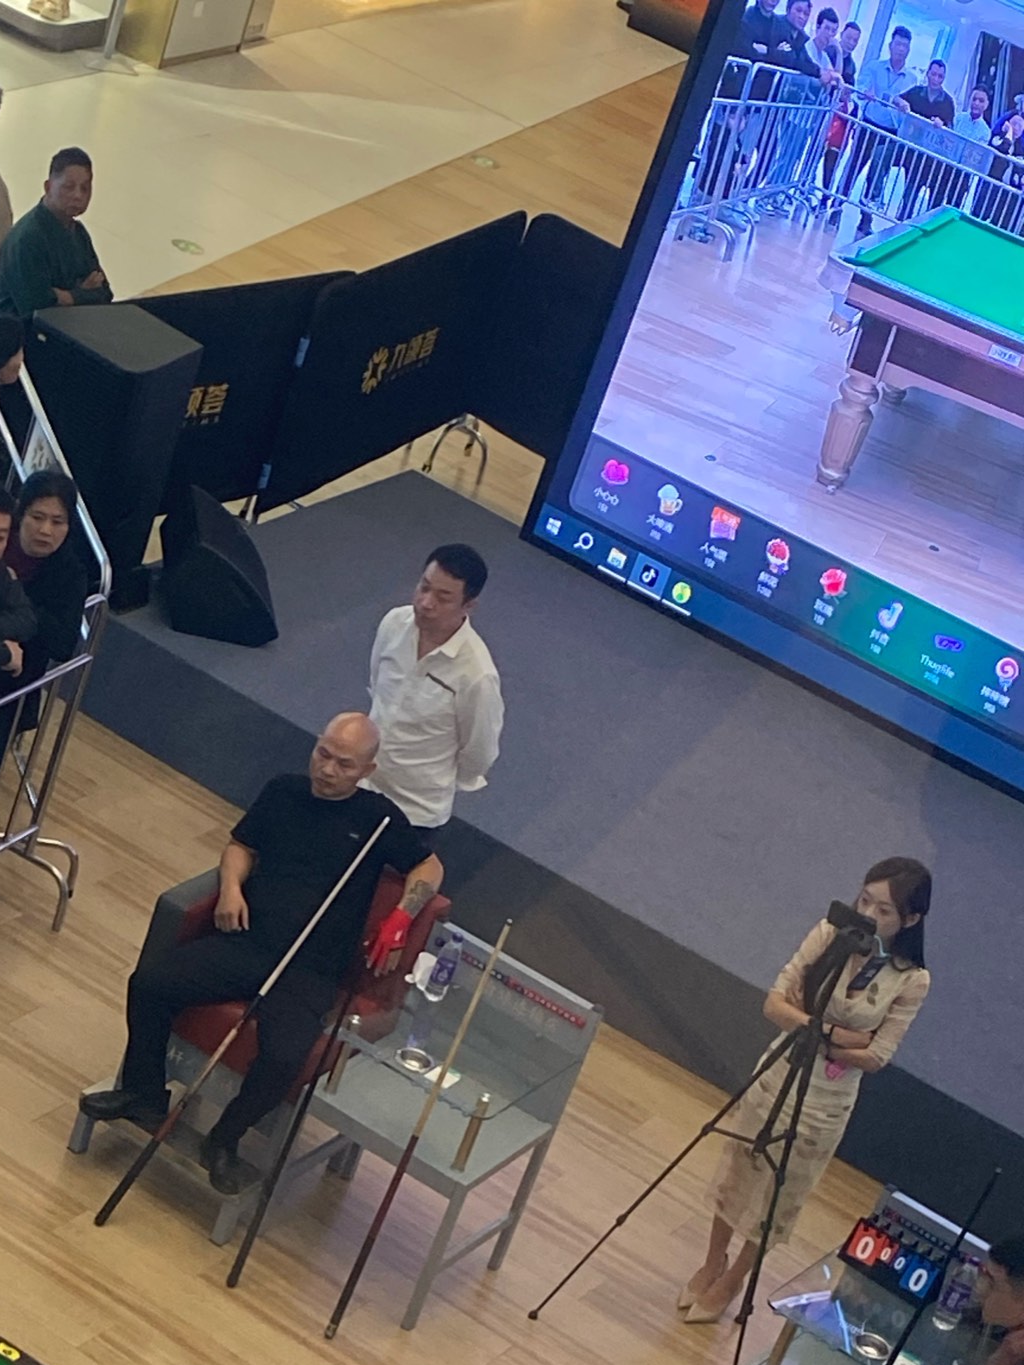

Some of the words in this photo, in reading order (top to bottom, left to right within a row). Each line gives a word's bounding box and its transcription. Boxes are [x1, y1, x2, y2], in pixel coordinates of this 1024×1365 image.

[855, 1236, 875, 1260] 0
[880, 1248, 892, 1261] 0
[893, 1256, 906, 1271] 0
[908, 1268, 928, 1292] 0
